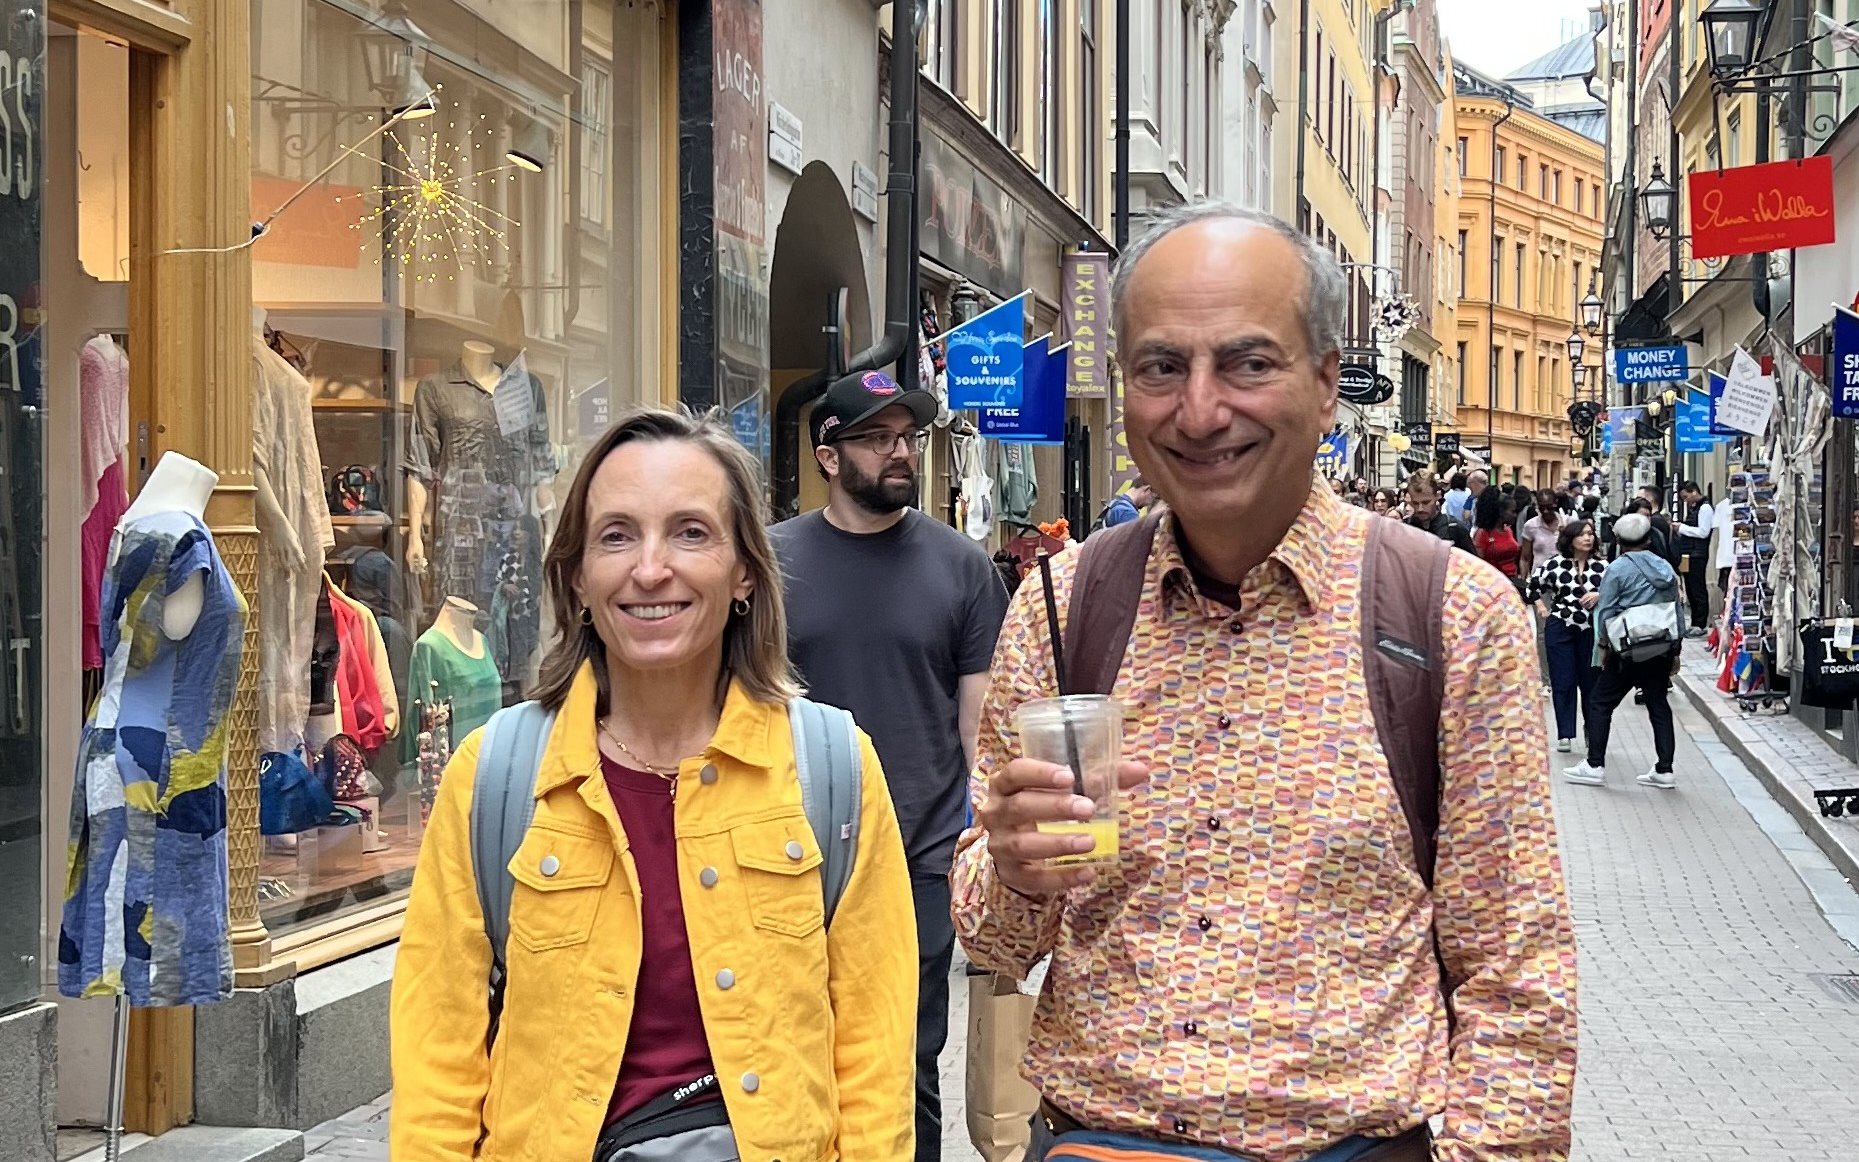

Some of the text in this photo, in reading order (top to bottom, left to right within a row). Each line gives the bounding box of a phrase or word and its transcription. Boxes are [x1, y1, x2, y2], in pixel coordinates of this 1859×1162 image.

[717, 49, 760, 117] LAGER
[1074, 263, 1096, 382] EXCHANGE
[971, 355, 1001, 365] GIFTS
[1627, 350, 1676, 364] MONEY
[981, 366, 990, 375] &
[1623, 365, 1681, 379] CHANGE
[955, 376, 1017, 386] SOUVENIRS
